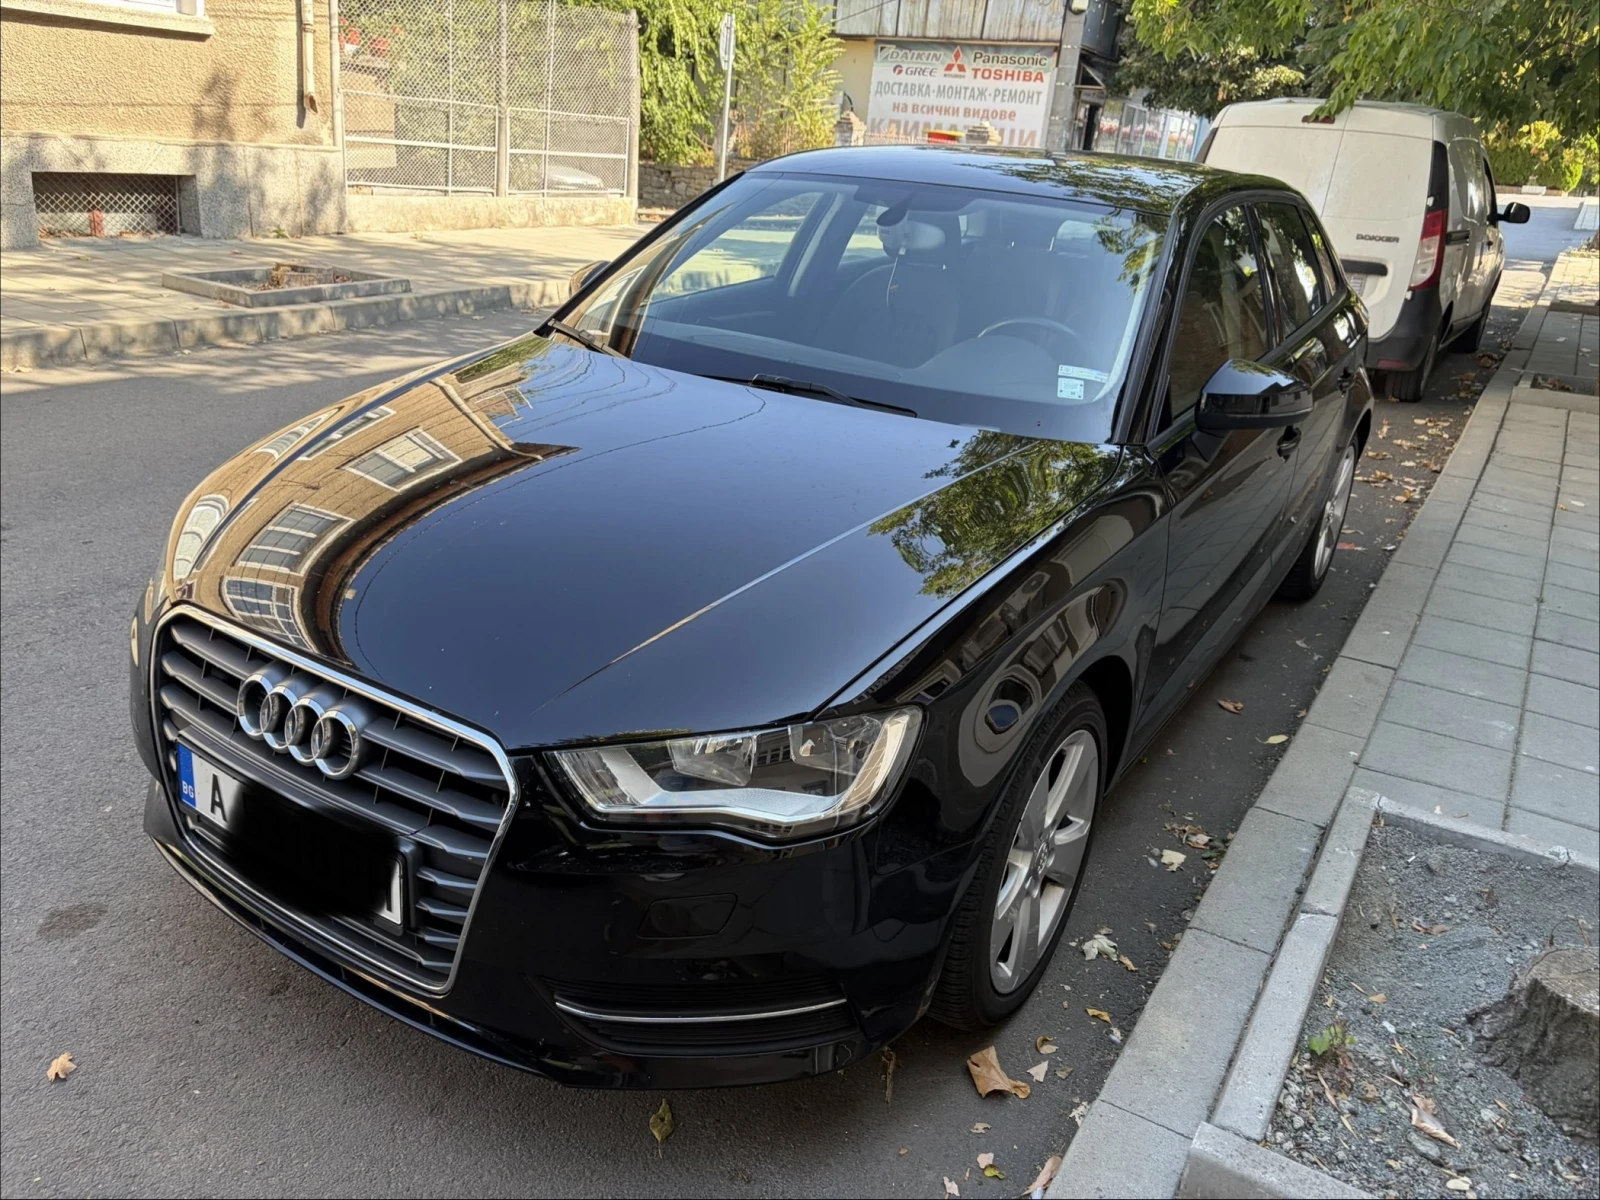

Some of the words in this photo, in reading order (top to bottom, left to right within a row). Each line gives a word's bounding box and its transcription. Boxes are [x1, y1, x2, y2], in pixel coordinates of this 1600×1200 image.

[889, 50, 942, 62] DAIKIN
[972, 51, 1048, 66] Panasonic
[905, 66, 938, 78] GREE
[971, 68, 1044, 83] TOSHIBA
[892, 102, 908, 113] на
[912, 103, 959, 117] всички
[963, 106, 1016, 121] видове
[182, 780, 194, 799] BG
